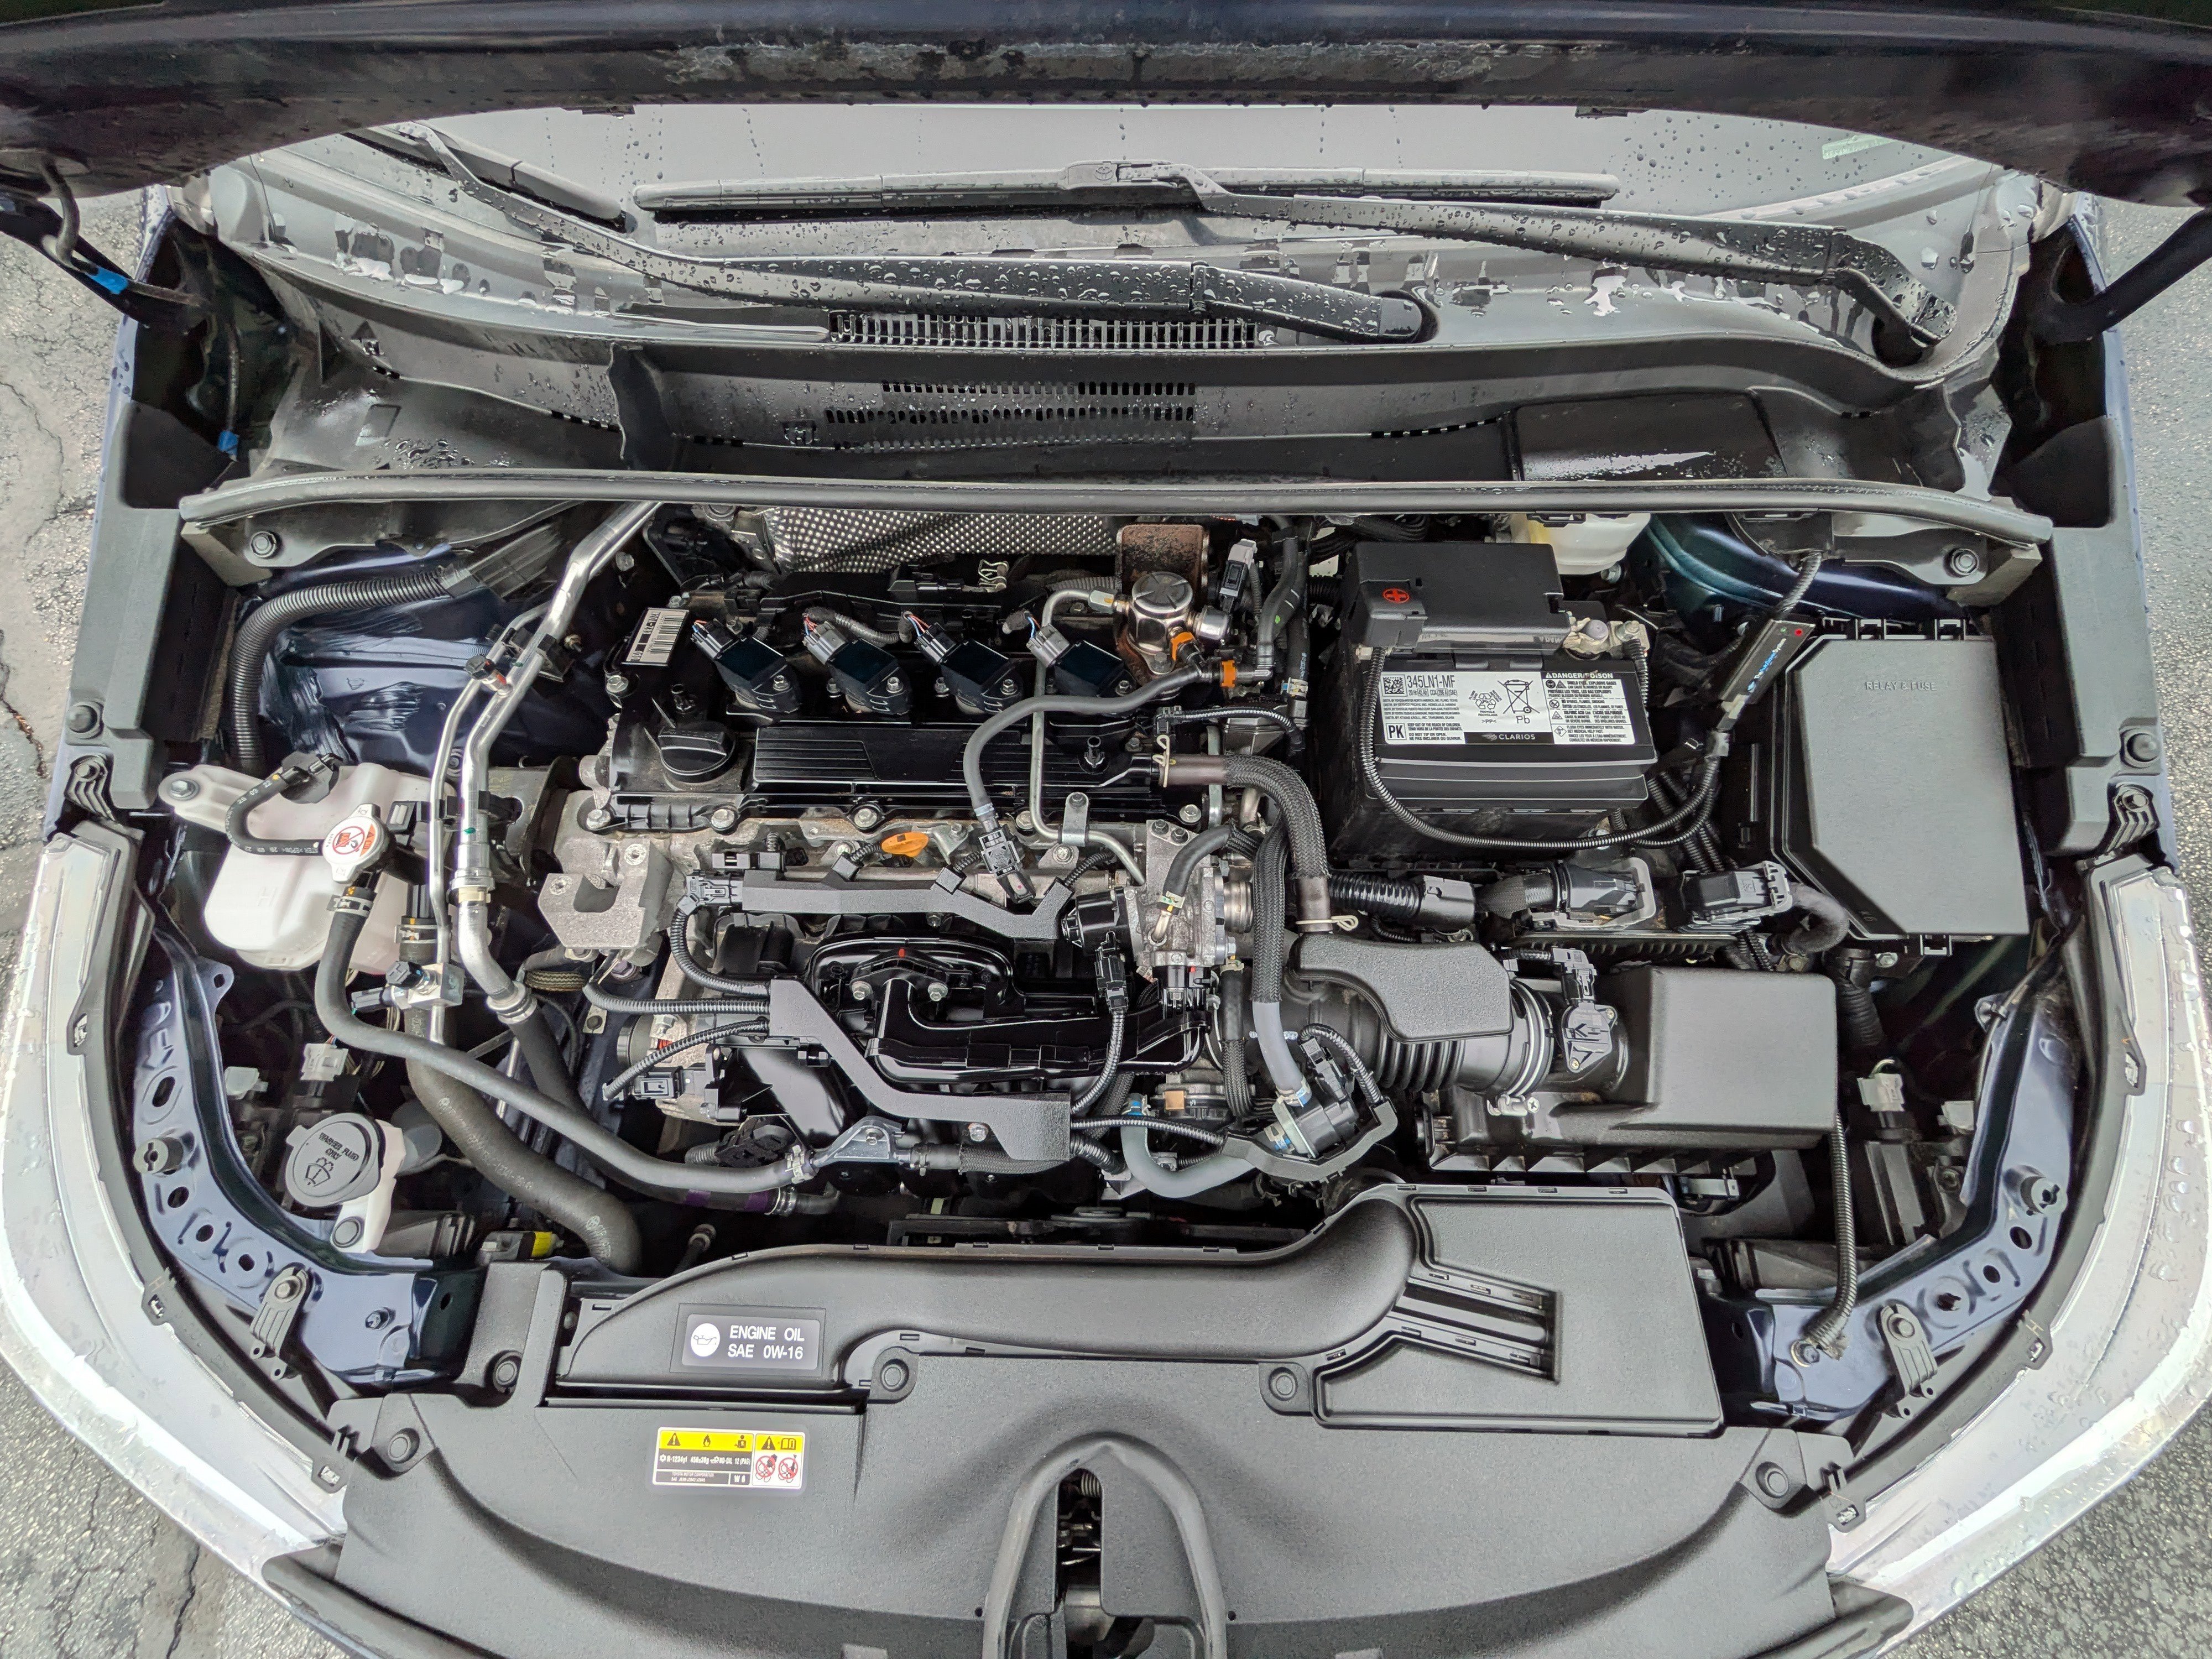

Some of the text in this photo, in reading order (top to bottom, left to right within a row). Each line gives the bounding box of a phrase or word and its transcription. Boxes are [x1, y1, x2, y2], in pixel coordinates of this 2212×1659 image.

[1407, 675, 1455, 687] 345LN1-MF
[1865, 681, 1937, 691] RELAY & FUSE
[1516, 716, 1530, 724] Pb
[1389, 725, 1404, 738] PK
[319, 1132, 342, 1151] WASHER
[730, 1325, 805, 1342] ENGINE OIL
[728, 1343, 804, 1359] SAE 0W-16
